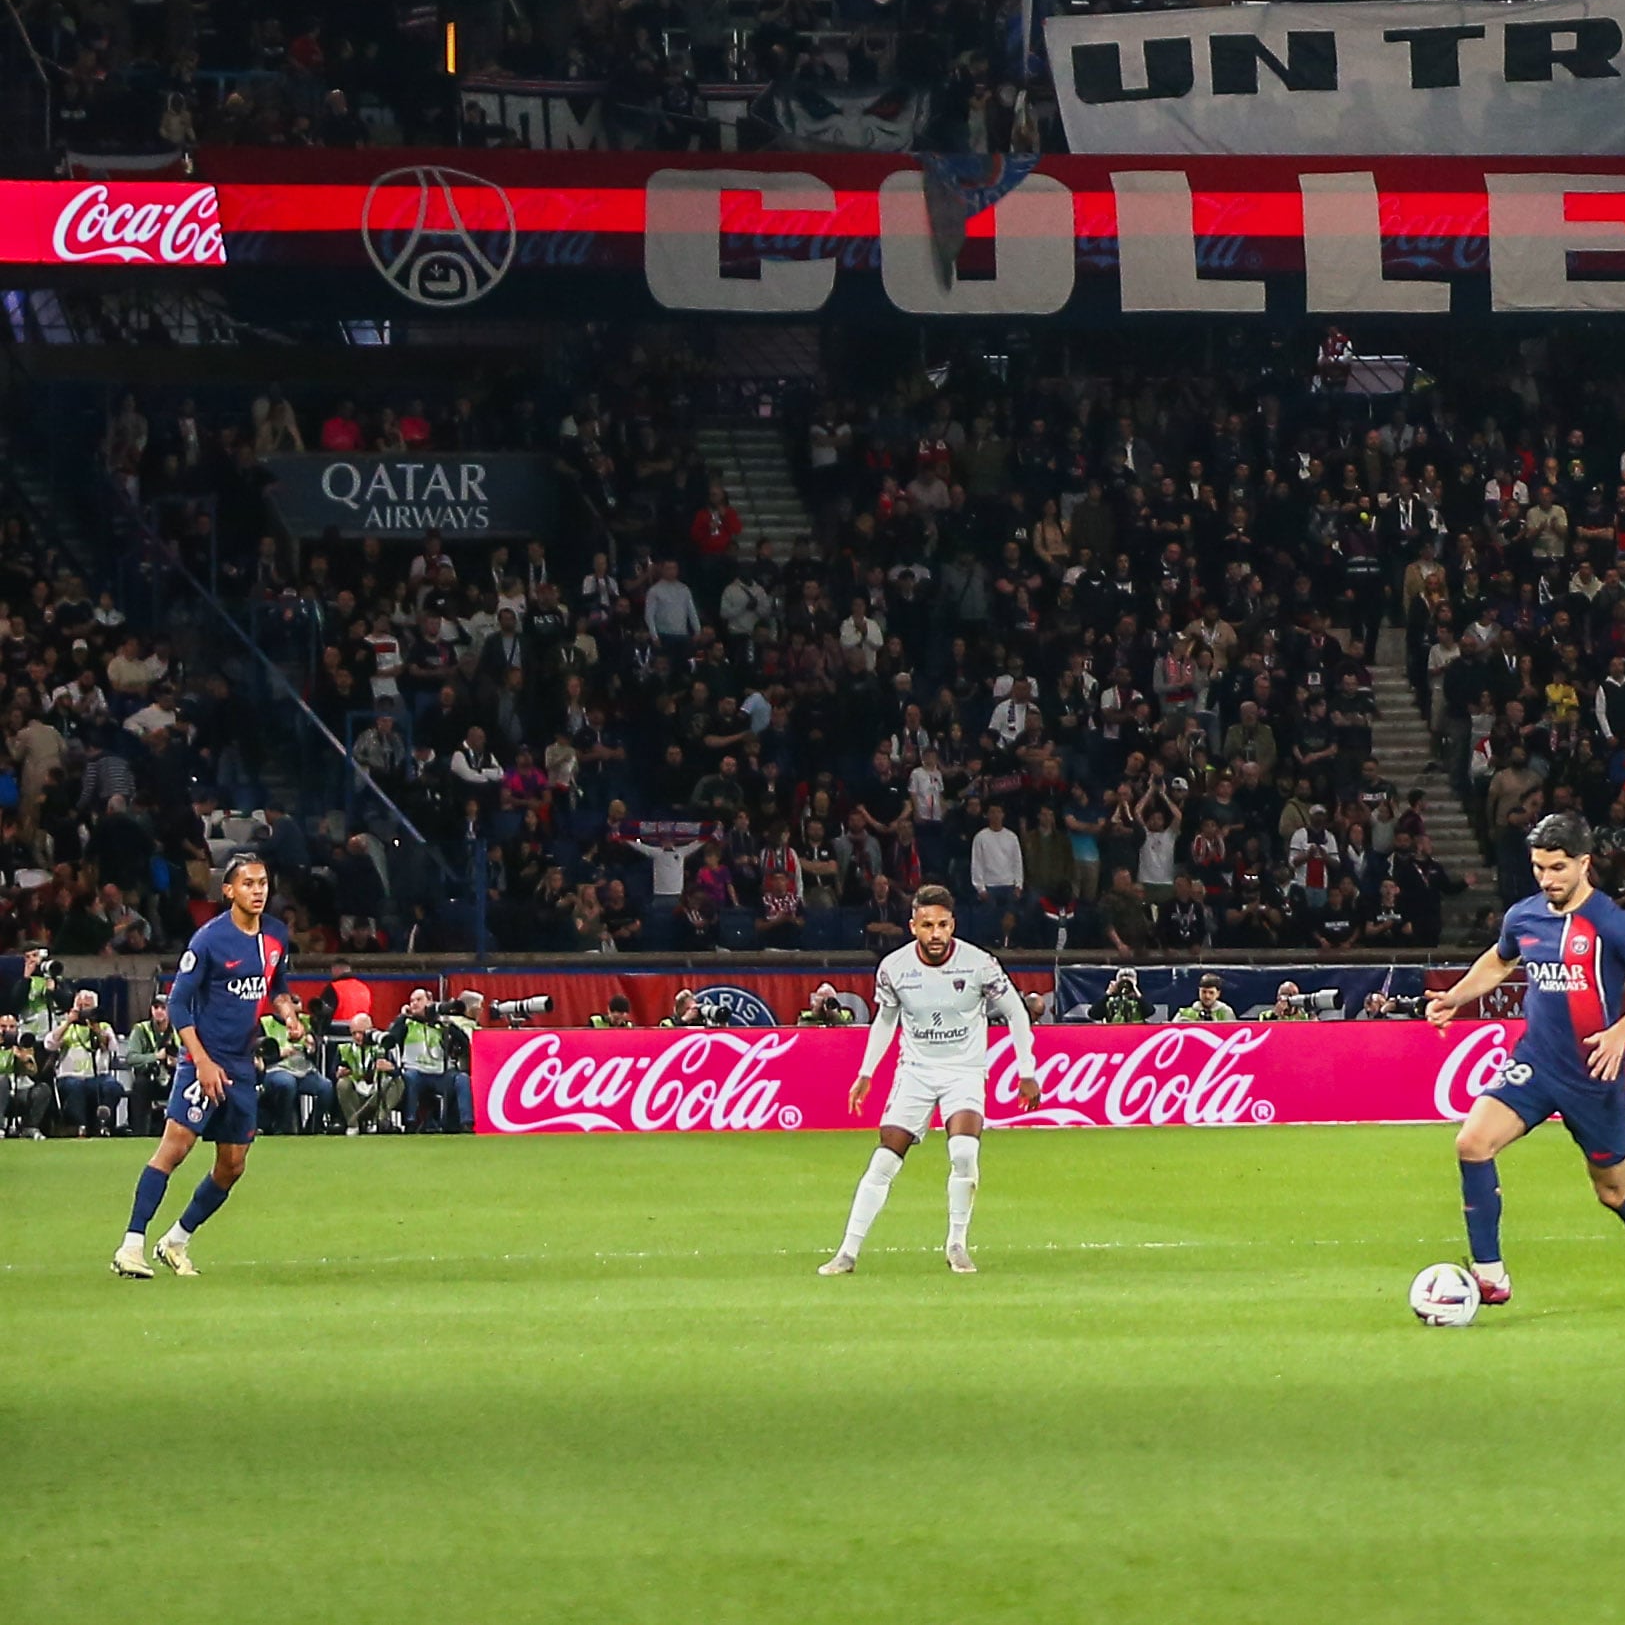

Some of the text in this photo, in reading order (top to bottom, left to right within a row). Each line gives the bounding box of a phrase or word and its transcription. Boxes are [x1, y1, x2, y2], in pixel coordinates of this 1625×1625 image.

[1070, 31, 1338, 104] UN
[321, 462, 489, 510] QATAR
[364, 505, 490, 529] AIRWAYS
[486, 1031, 799, 1133] Coca-Cola
